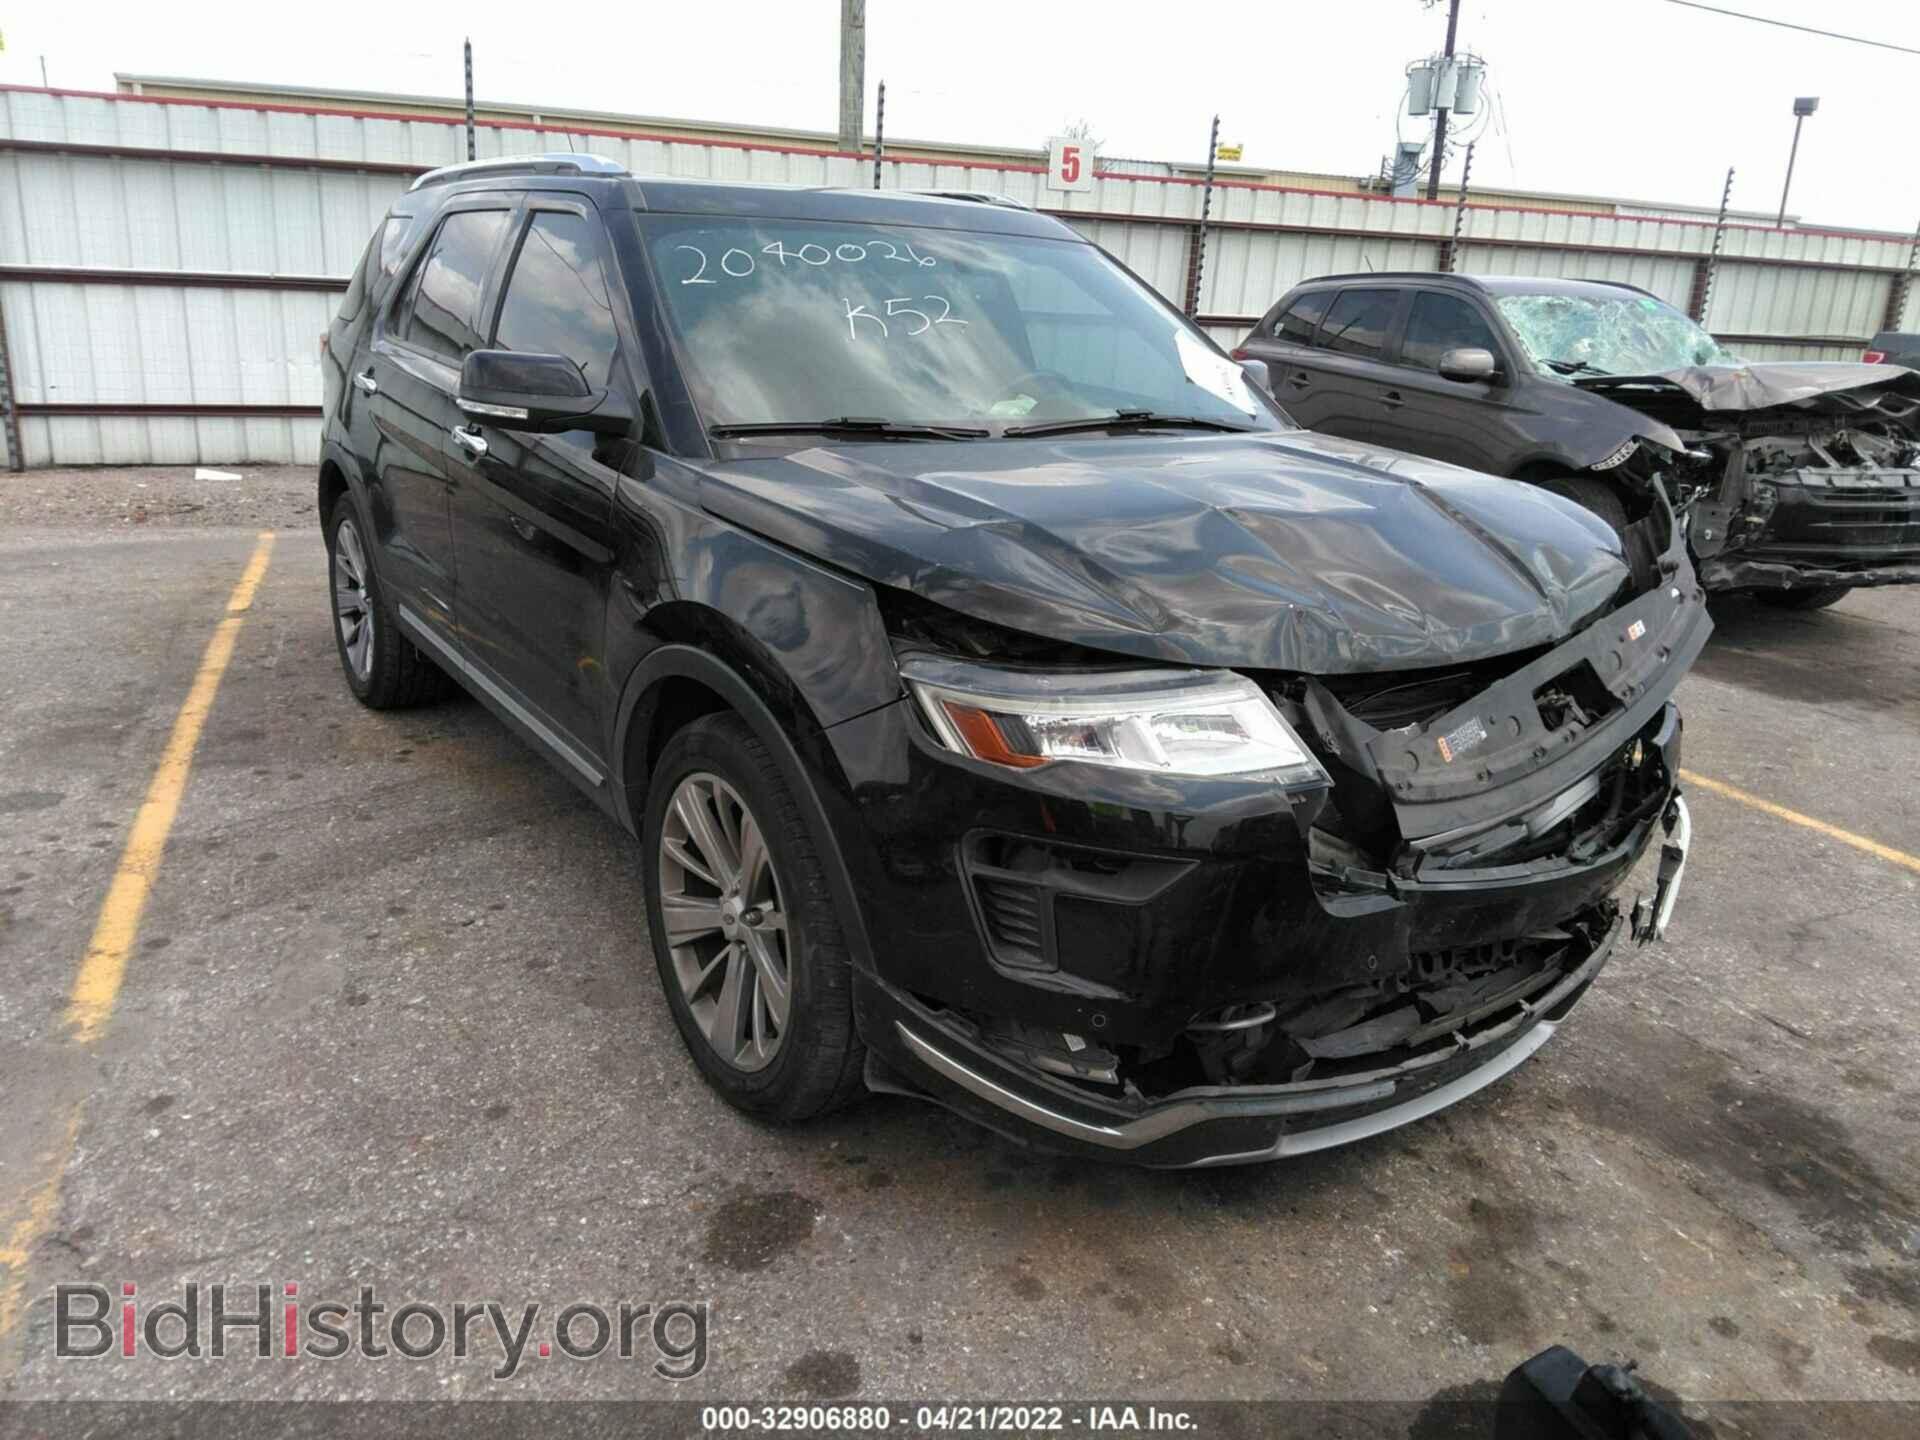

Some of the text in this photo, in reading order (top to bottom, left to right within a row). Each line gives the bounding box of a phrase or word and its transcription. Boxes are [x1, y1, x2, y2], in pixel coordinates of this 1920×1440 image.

[1061, 146, 1080, 183] 5
[674, 240, 937, 285] 2040026
[843, 295, 969, 341] K52
